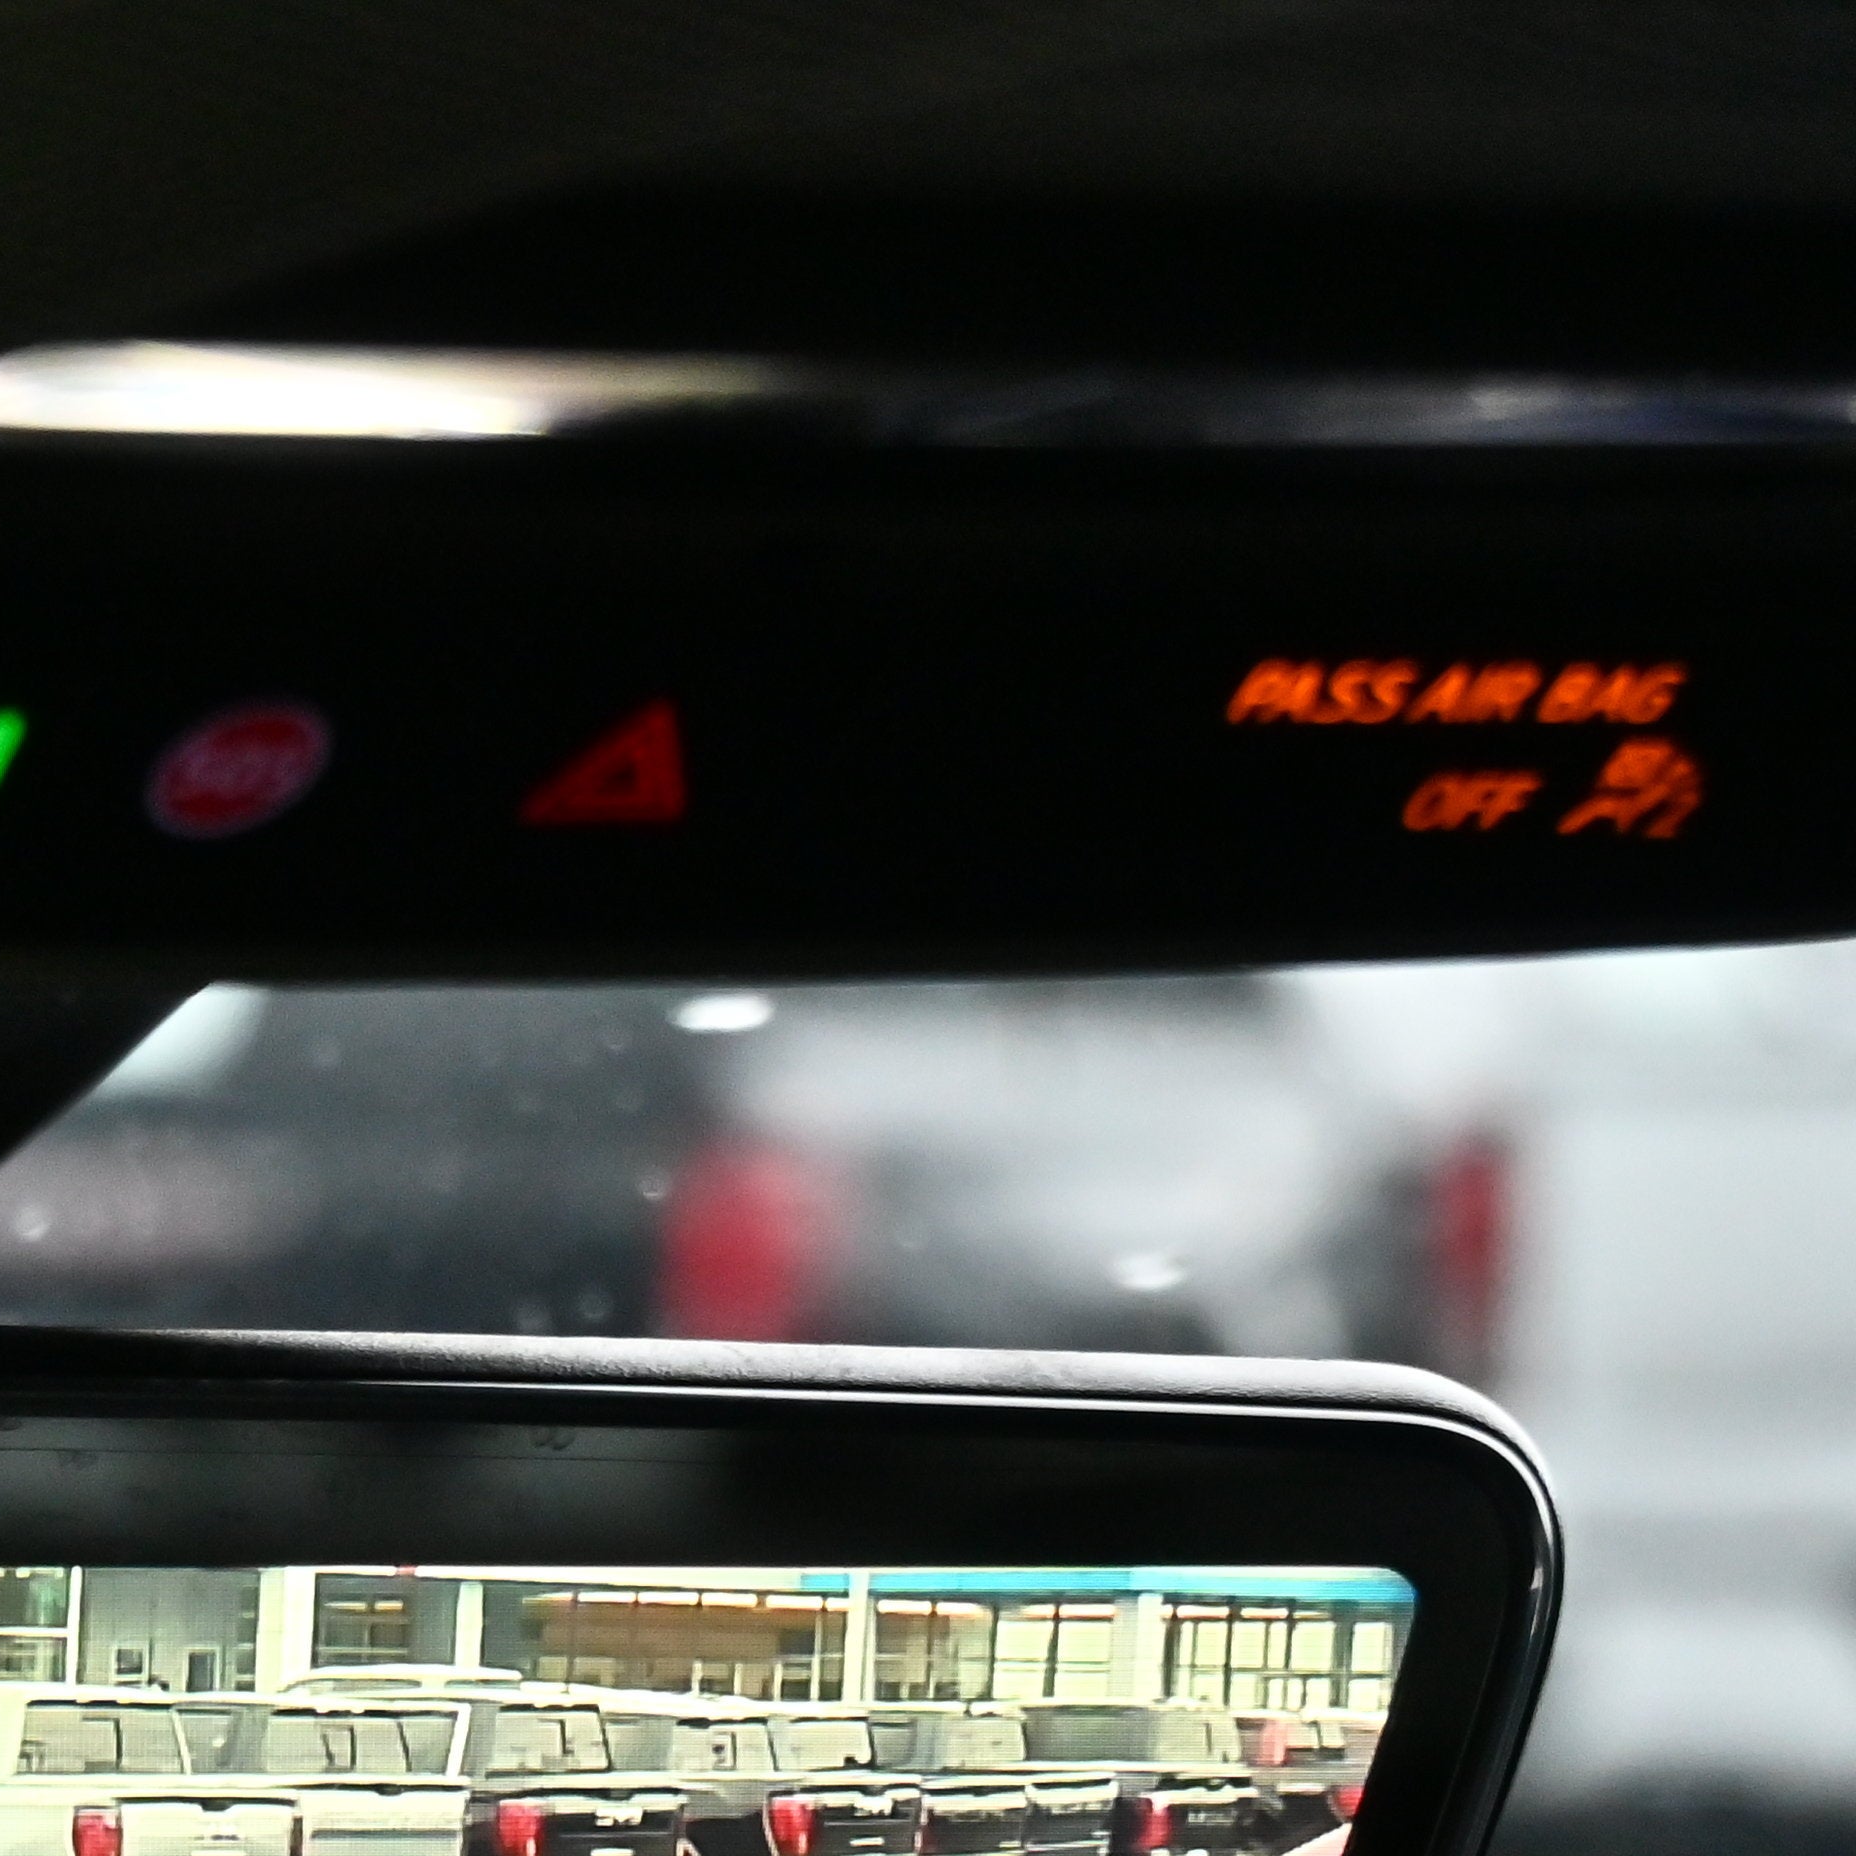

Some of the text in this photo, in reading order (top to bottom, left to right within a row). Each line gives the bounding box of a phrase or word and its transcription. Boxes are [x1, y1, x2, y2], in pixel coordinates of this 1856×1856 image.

[1226, 658, 1686, 725] PASS AIR BAG
[1401, 770, 1544, 832] OFF
